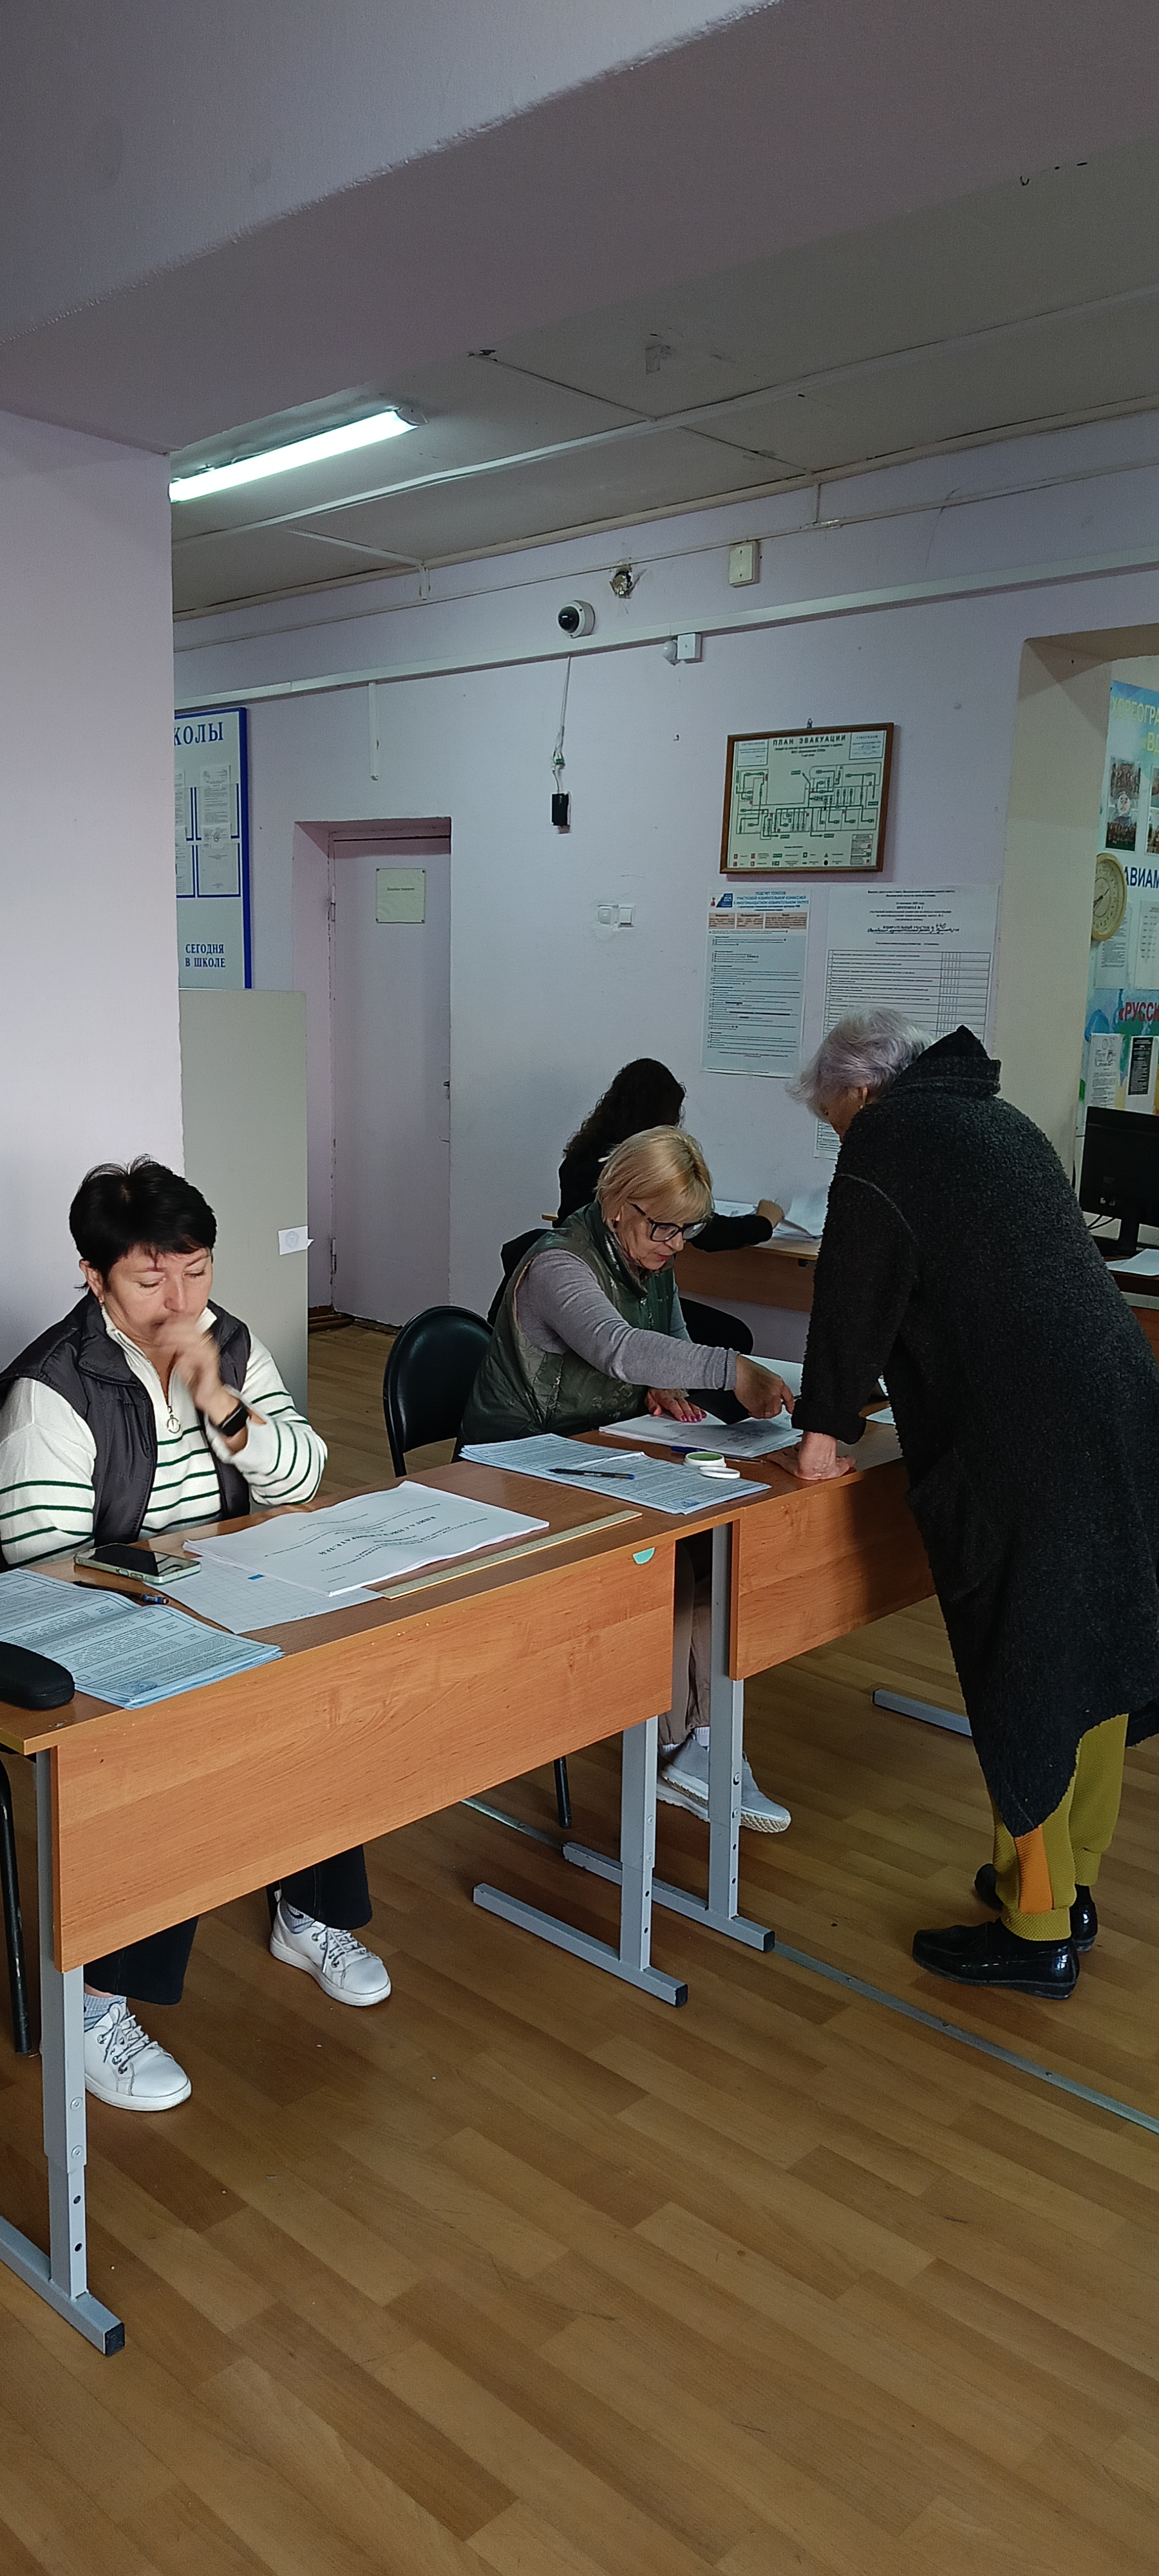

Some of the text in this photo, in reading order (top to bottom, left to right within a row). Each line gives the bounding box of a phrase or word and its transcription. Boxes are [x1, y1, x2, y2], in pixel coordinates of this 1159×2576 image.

[799, 735, 846, 744] ЭВАКУАЦИИ
[185, 943, 224, 956] СЕГОДНЯ
[185, 958, 225, 967] В ШКОЛЕ
